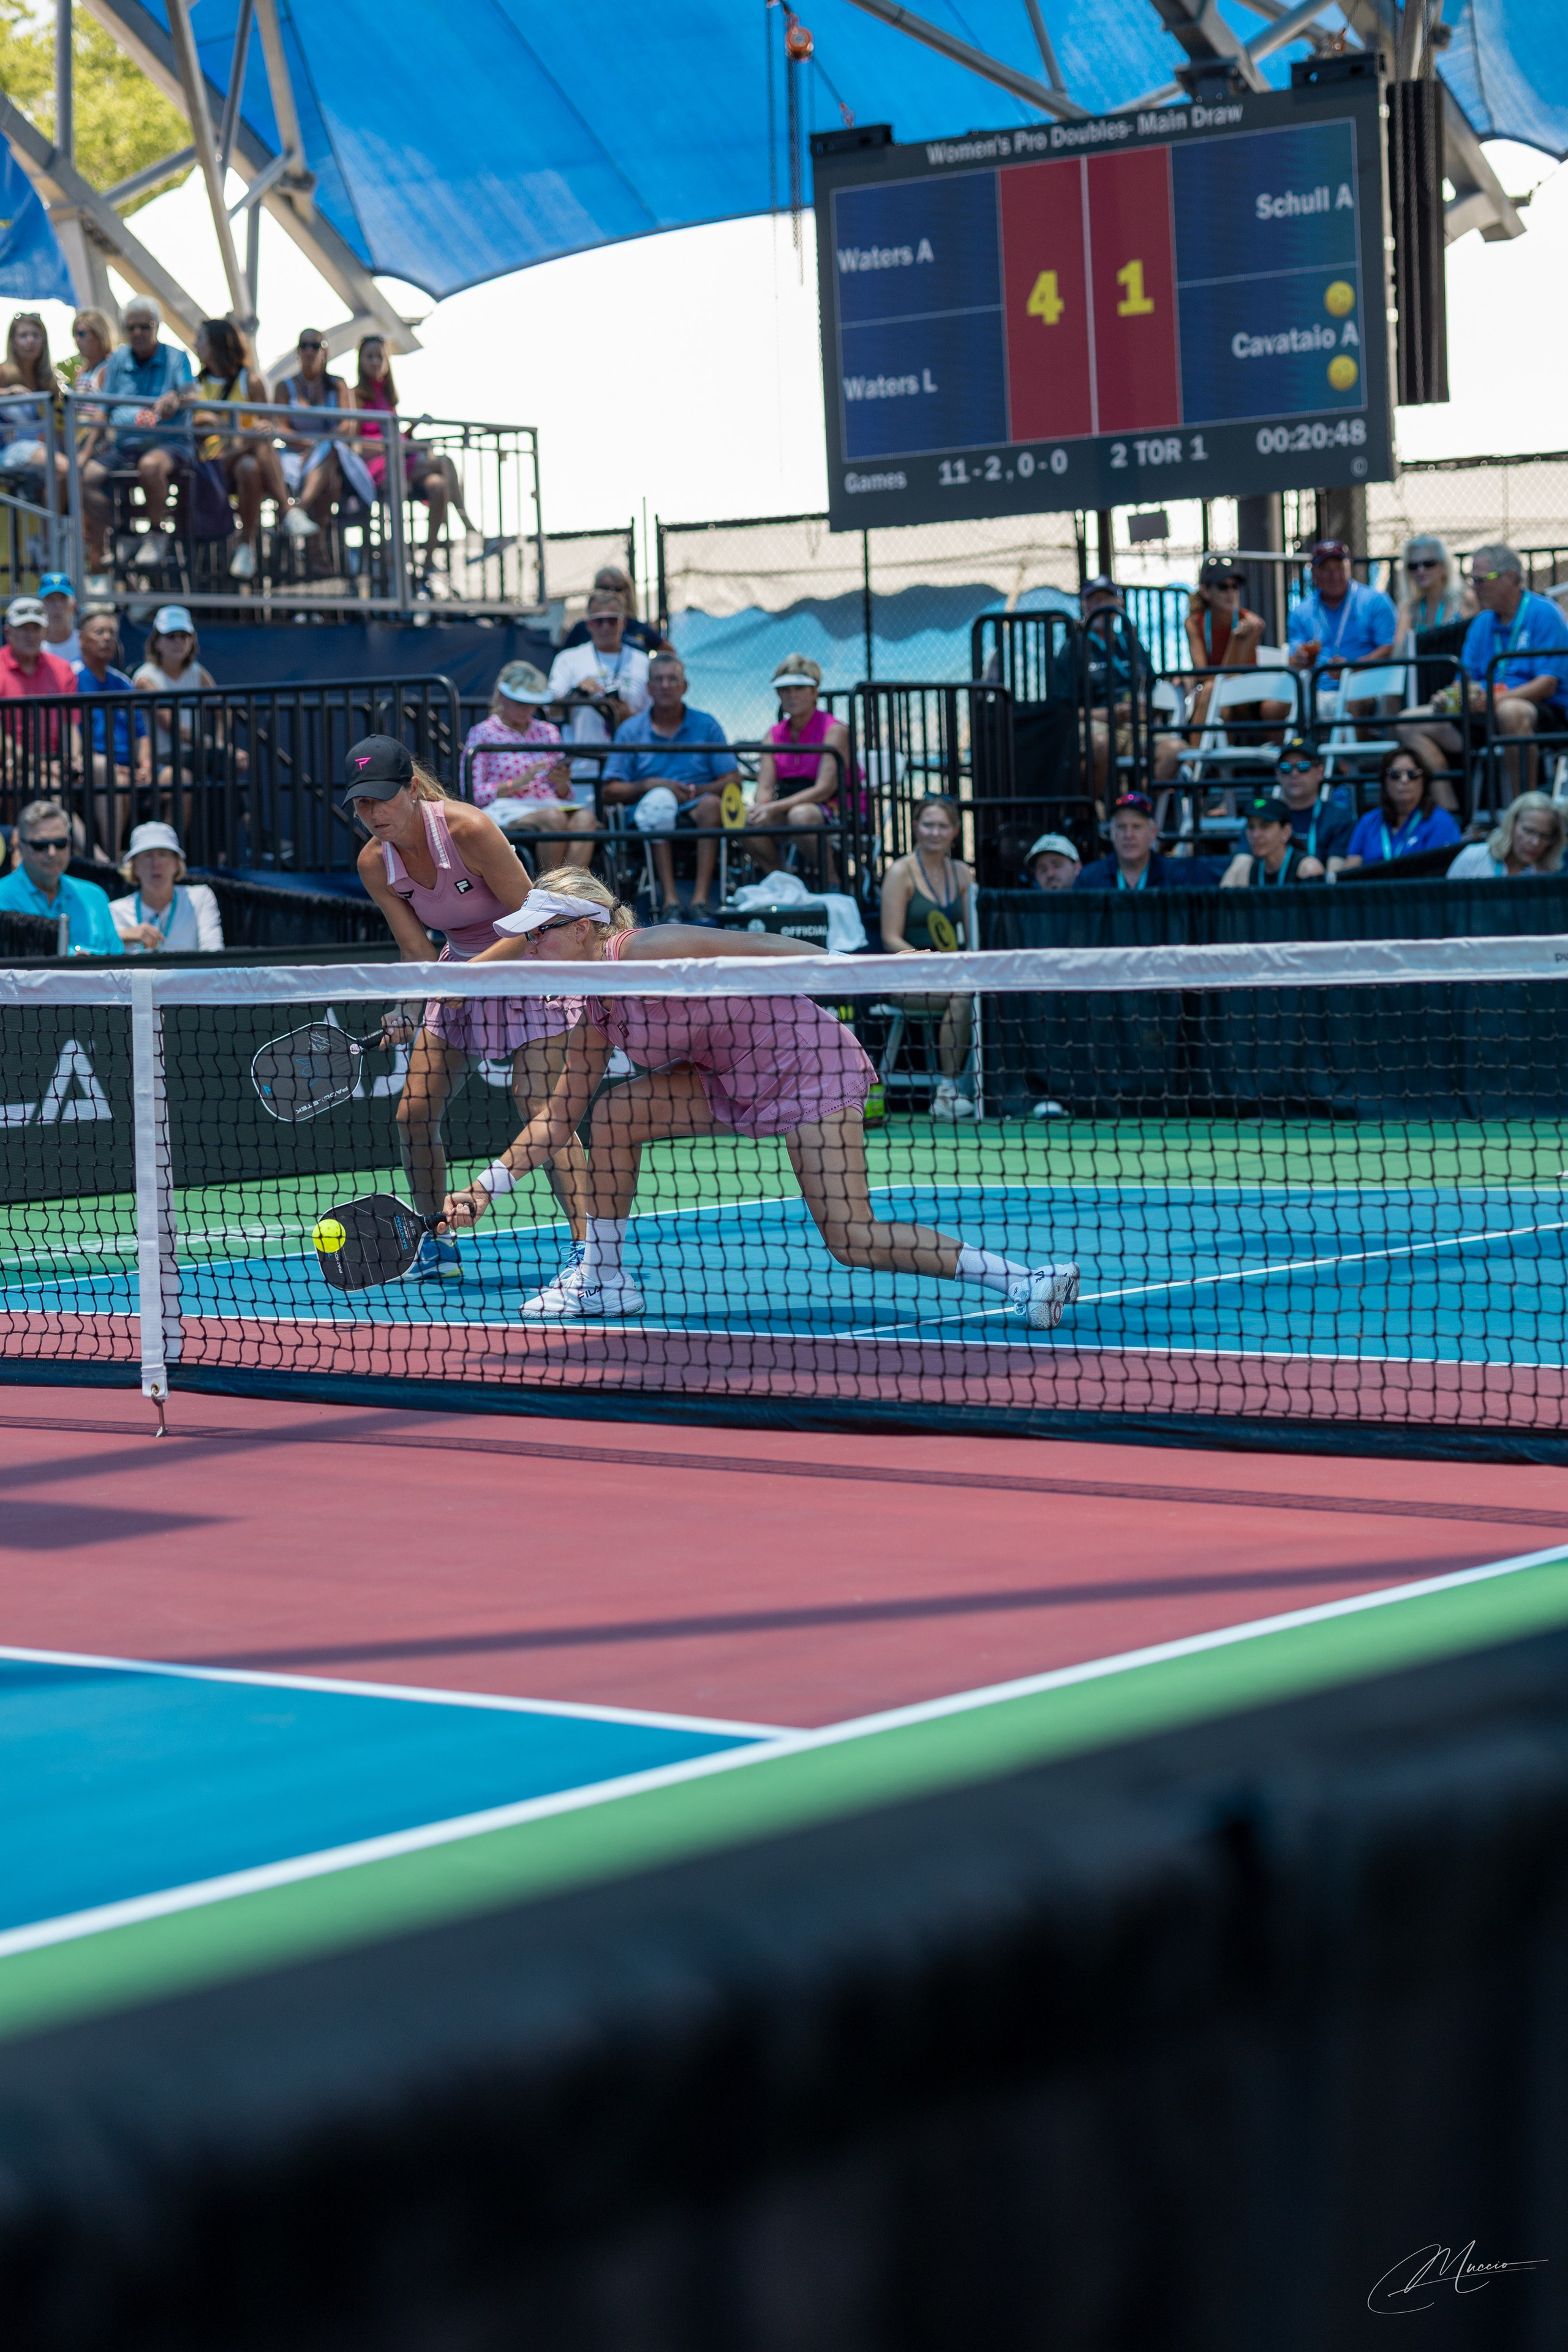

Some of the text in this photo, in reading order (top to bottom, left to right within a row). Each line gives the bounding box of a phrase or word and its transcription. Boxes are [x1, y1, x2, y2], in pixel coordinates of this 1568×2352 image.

[926, 134, 1011, 165] Women's
[1014, 130, 1047, 153] Pro
[1137, 109, 1187, 135] Main
[1191, 104, 1243, 128] Draw
[1256, 183, 1354, 220] Schull A
[837, 238, 935, 274] Waters A
[1027, 270, 1065, 326] 4
[1117, 258, 1155, 317] 1
[1231, 320, 1359, 359] Cavataio A
[843, 368, 938, 402] Waters L
[1110, 434, 1209, 469] 2 TOR 1
[1256, 418, 1367, 454] 00:20:48
[844, 471, 908, 494] Games
[578, 1284, 601, 1301] FILA
